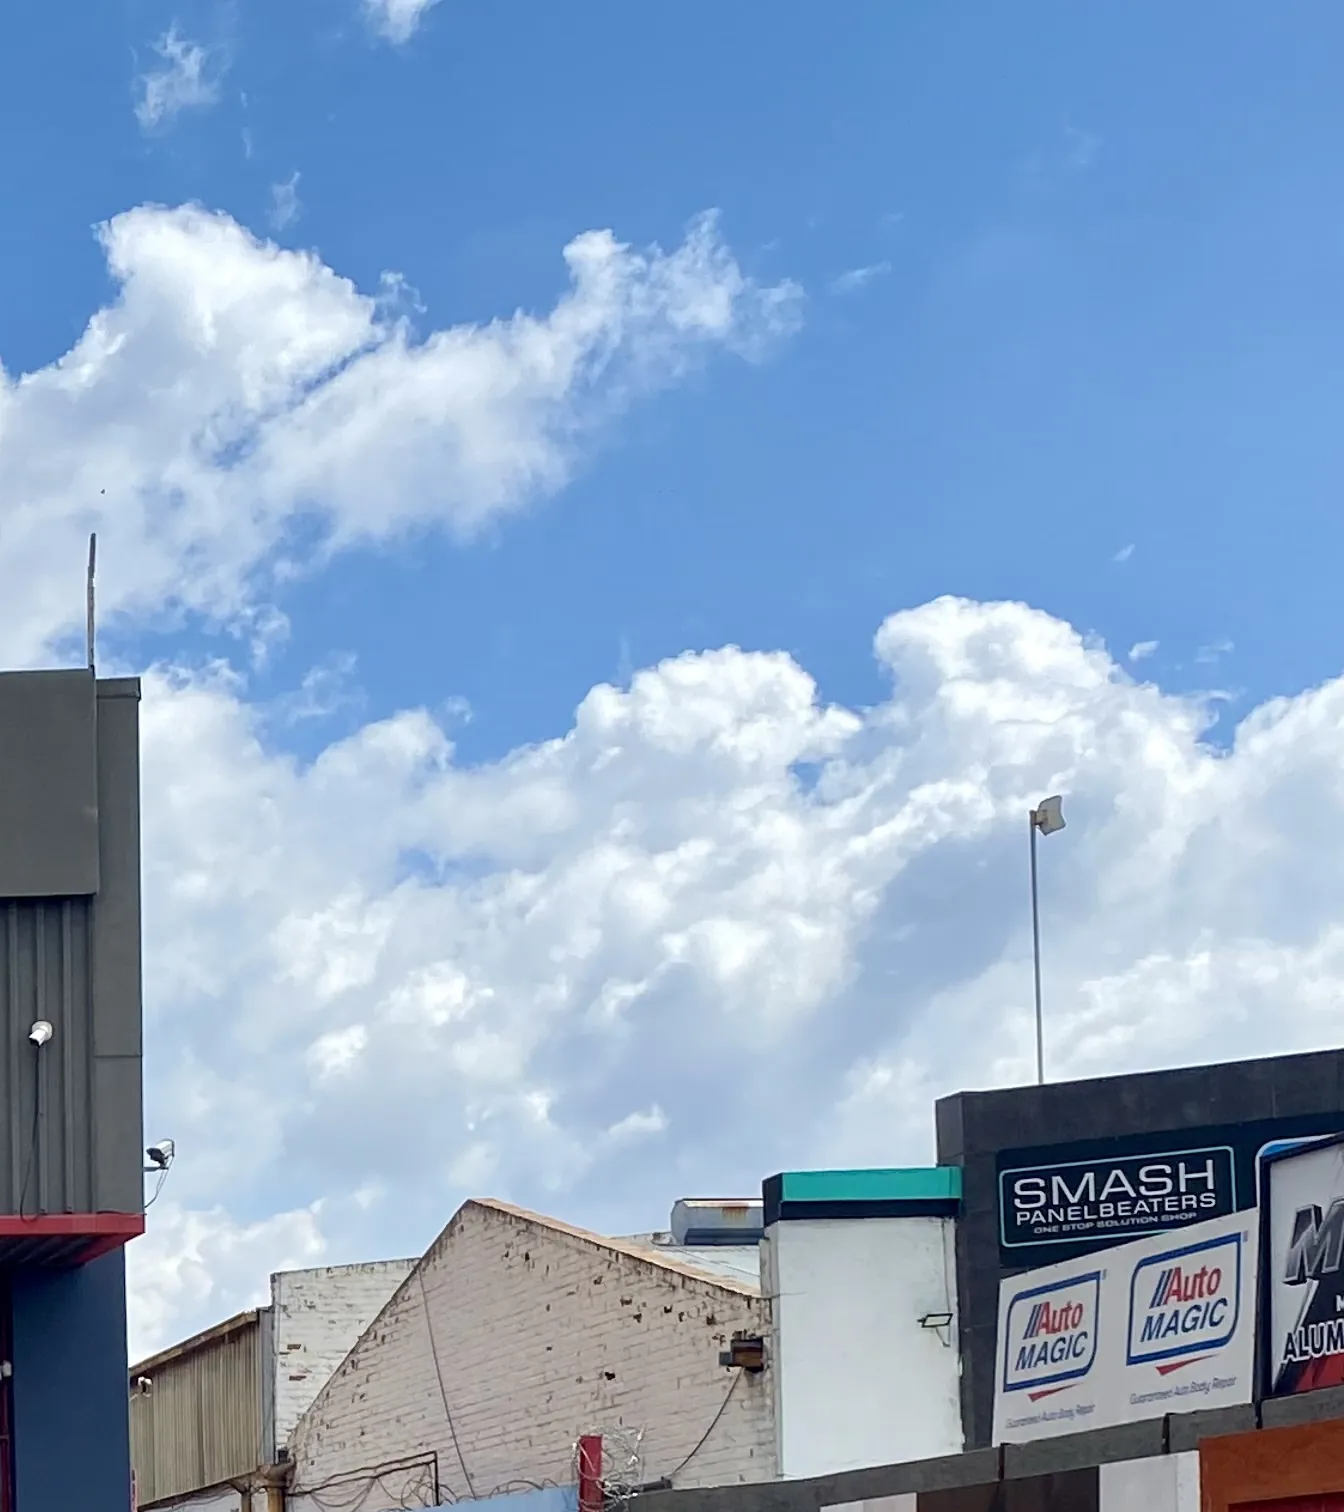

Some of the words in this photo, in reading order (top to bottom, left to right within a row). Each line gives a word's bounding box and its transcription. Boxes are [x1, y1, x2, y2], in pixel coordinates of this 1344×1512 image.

[1014, 1159, 1215, 1209] SMASH
[1016, 1192, 1216, 1226] PANELBEATERS
[1033, 1223, 1060, 1234] ONE
[1062, 1221, 1095, 1232] STOP
[1096, 1215, 1159, 1229] SOLUTION
[1163, 1265, 1222, 1306] Auto
[1035, 1300, 1084, 1336] Auto
[1140, 1297, 1229, 1343] MAGIC
[1015, 1331, 1088, 1371] MAGIC
